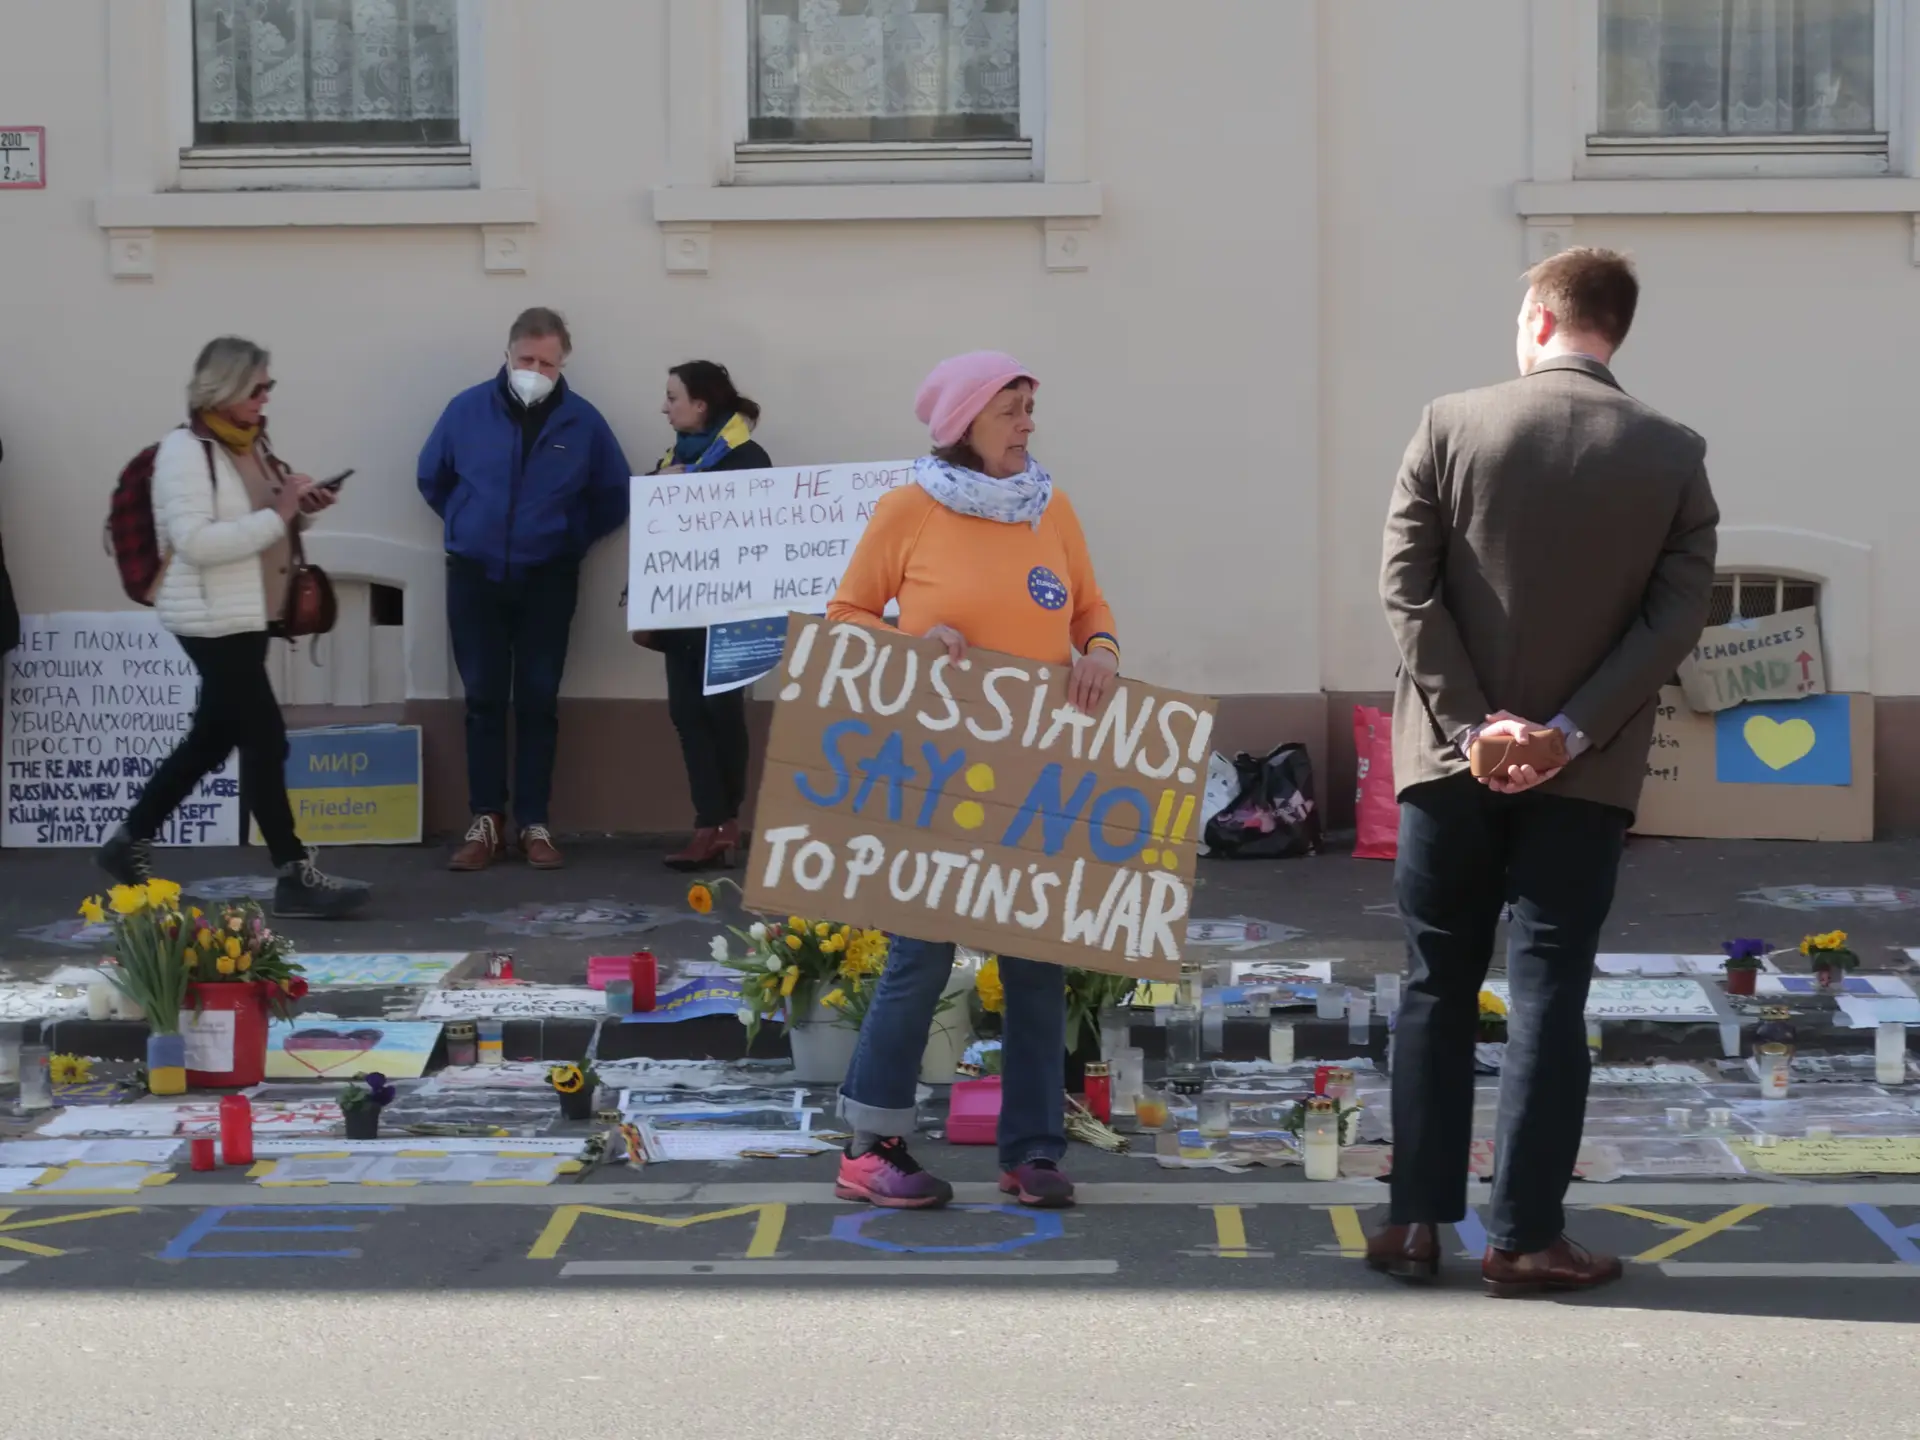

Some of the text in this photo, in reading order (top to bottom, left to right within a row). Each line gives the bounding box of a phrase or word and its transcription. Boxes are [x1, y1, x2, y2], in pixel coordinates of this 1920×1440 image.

[648, 467, 916, 508] АРМИЯ РФ НЕ ВОЮЕТ
[646, 518, 666, 536] С
[678, 495, 844, 534] УКРАИНСКОЙ
[643, 538, 850, 576] АРМИЯ РФ ВОЮЕТ
[649, 576, 838, 614] МИРНЫМ НАСЕЛ
[74, 630, 159, 652] ПЛОХИХ
[11, 659, 201, 680] ХОРОШИХ РУССКИ
[1704, 657, 1793, 704] TAND
[10, 685, 81, 708] КОГДА
[92, 685, 182, 706] ПЛОХИЕ
[12, 736, 102, 757] ПРОСТО
[66, 758, 93, 778] ARE
[96, 757, 119, 778] NO
[308, 751, 370, 777] мир
[179, 803, 222, 821] KEPT
[299, 798, 378, 818] Frieden
[37, 822, 108, 845] SIMPLY
[762, 824, 836, 892] TO
[1061, 857, 1190, 962] WAR
